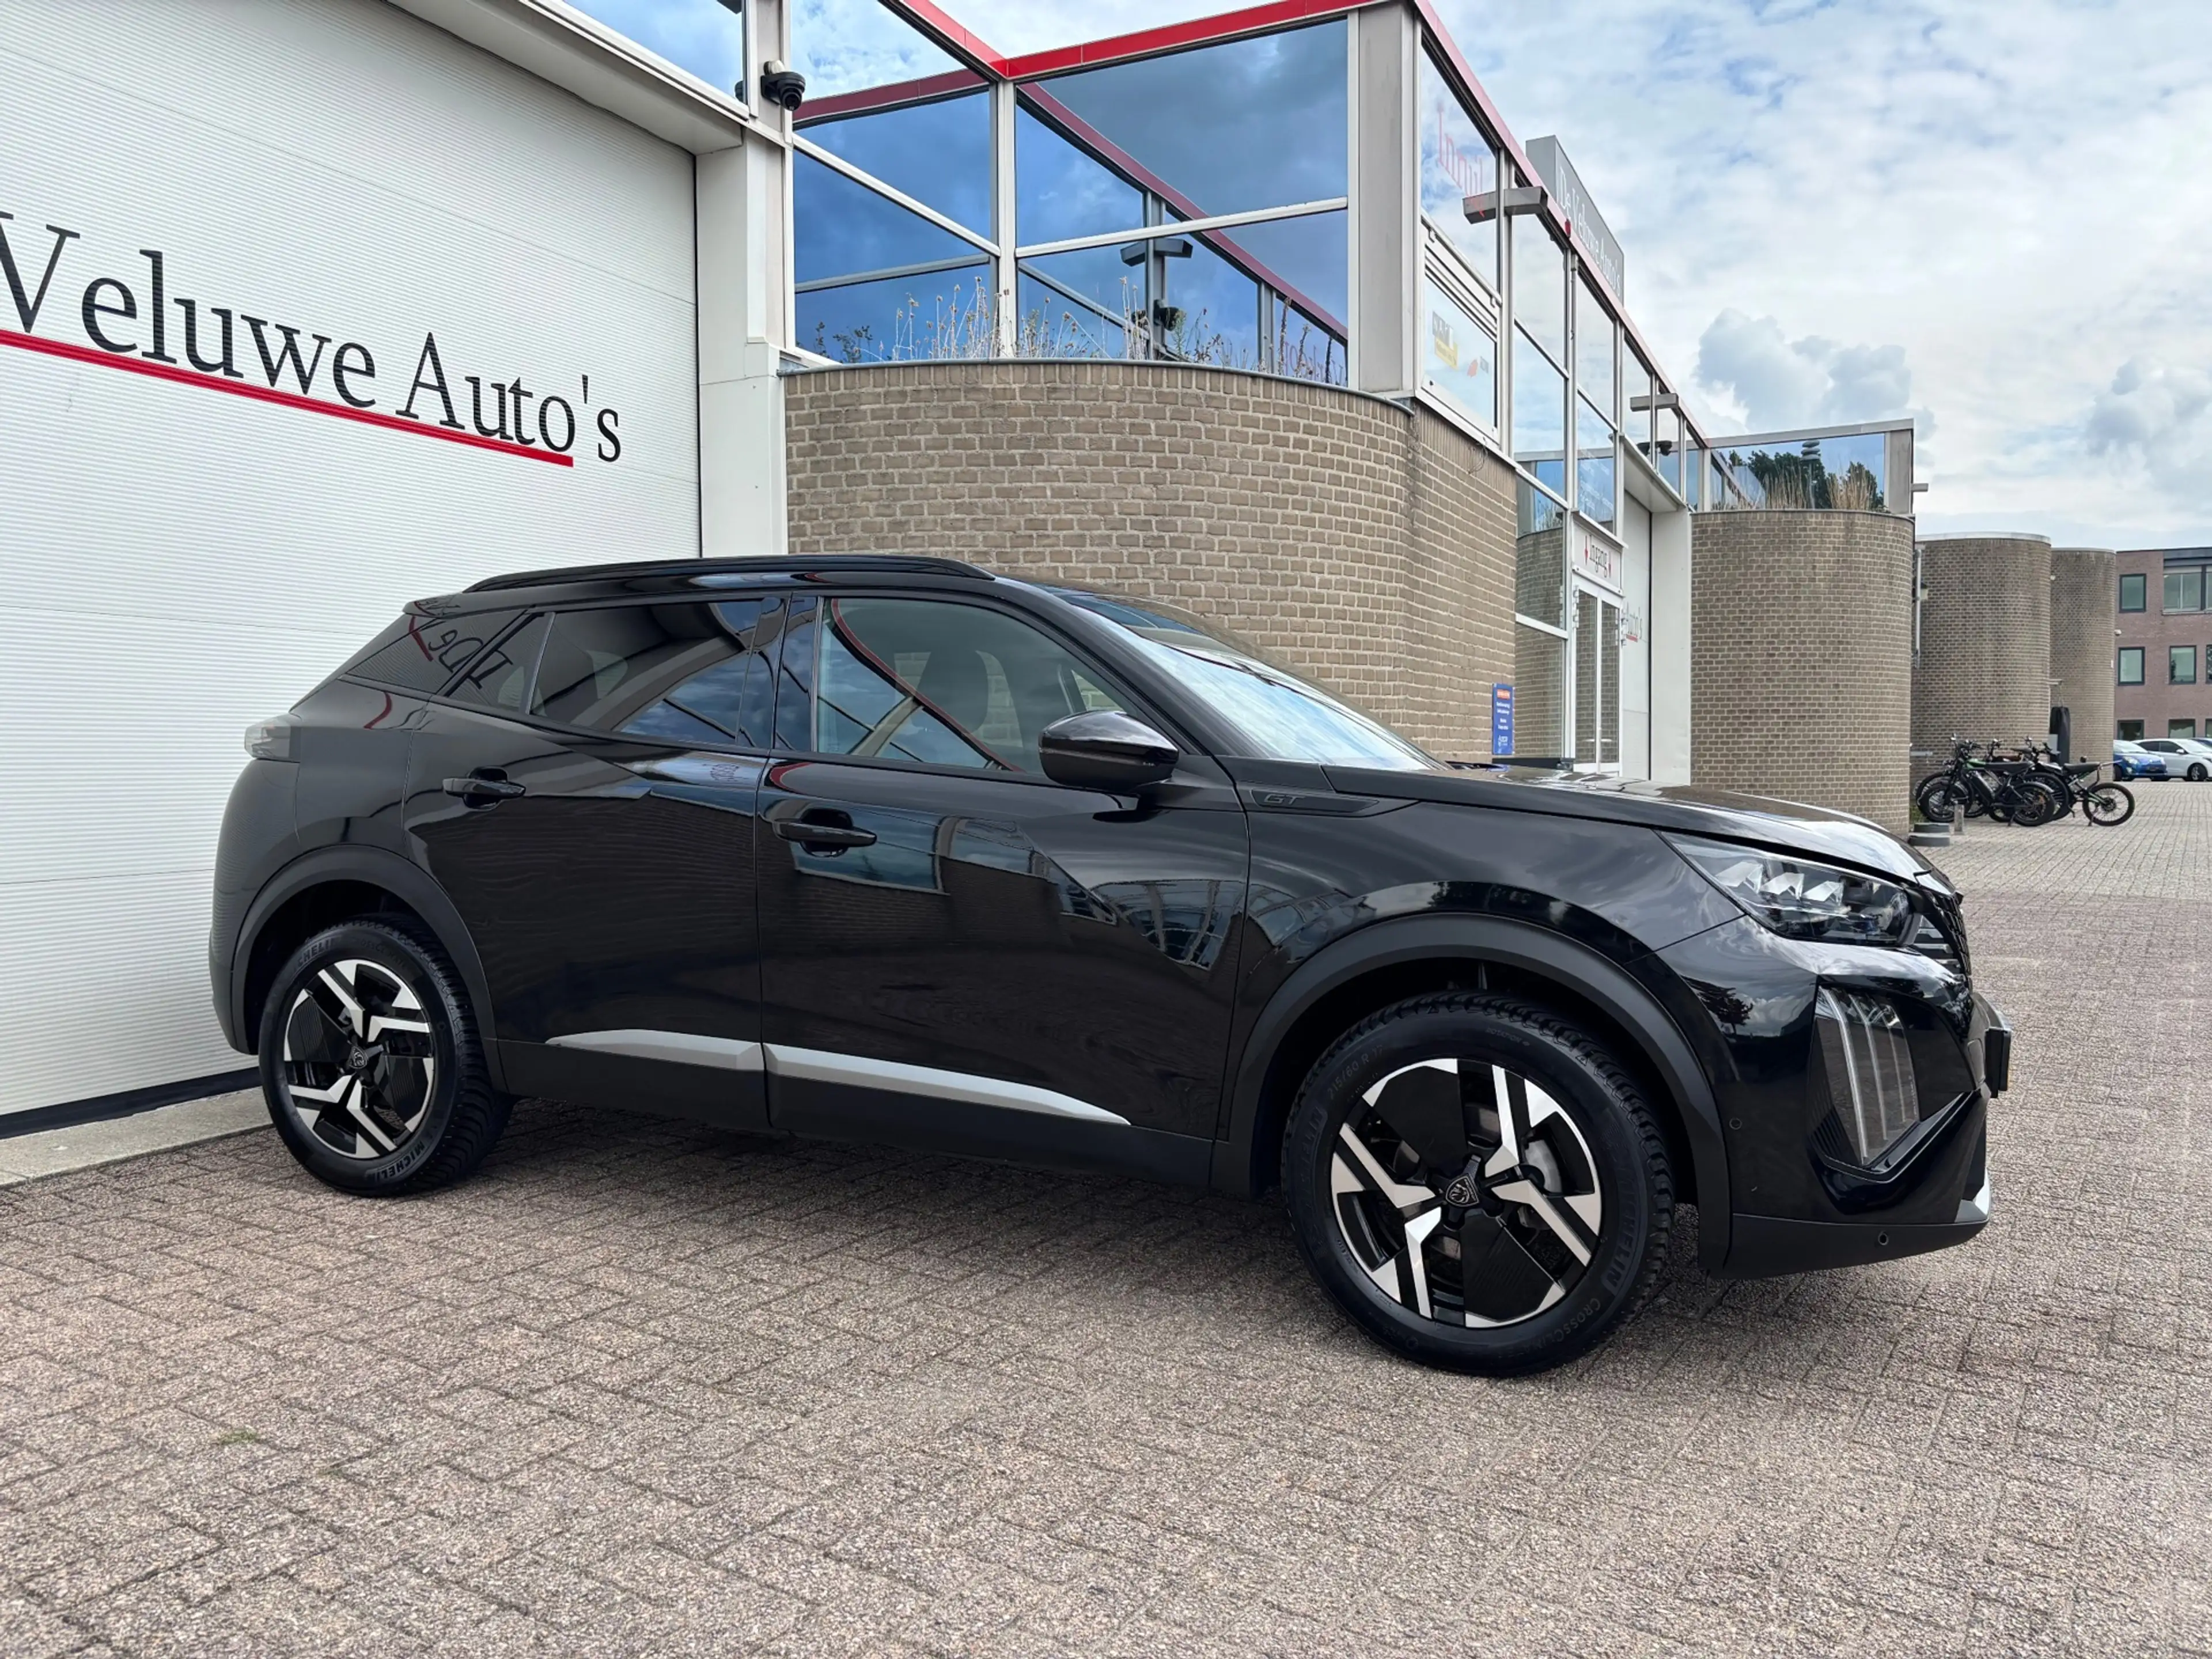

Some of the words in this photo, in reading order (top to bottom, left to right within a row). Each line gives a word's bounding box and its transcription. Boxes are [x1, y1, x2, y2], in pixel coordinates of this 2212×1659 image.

[0, 211, 376, 410] Veluwe
[395, 331, 622, 463] Auto's
[1589, 533, 1608, 578] Ingang
[1264, 793, 1306, 805] GT
